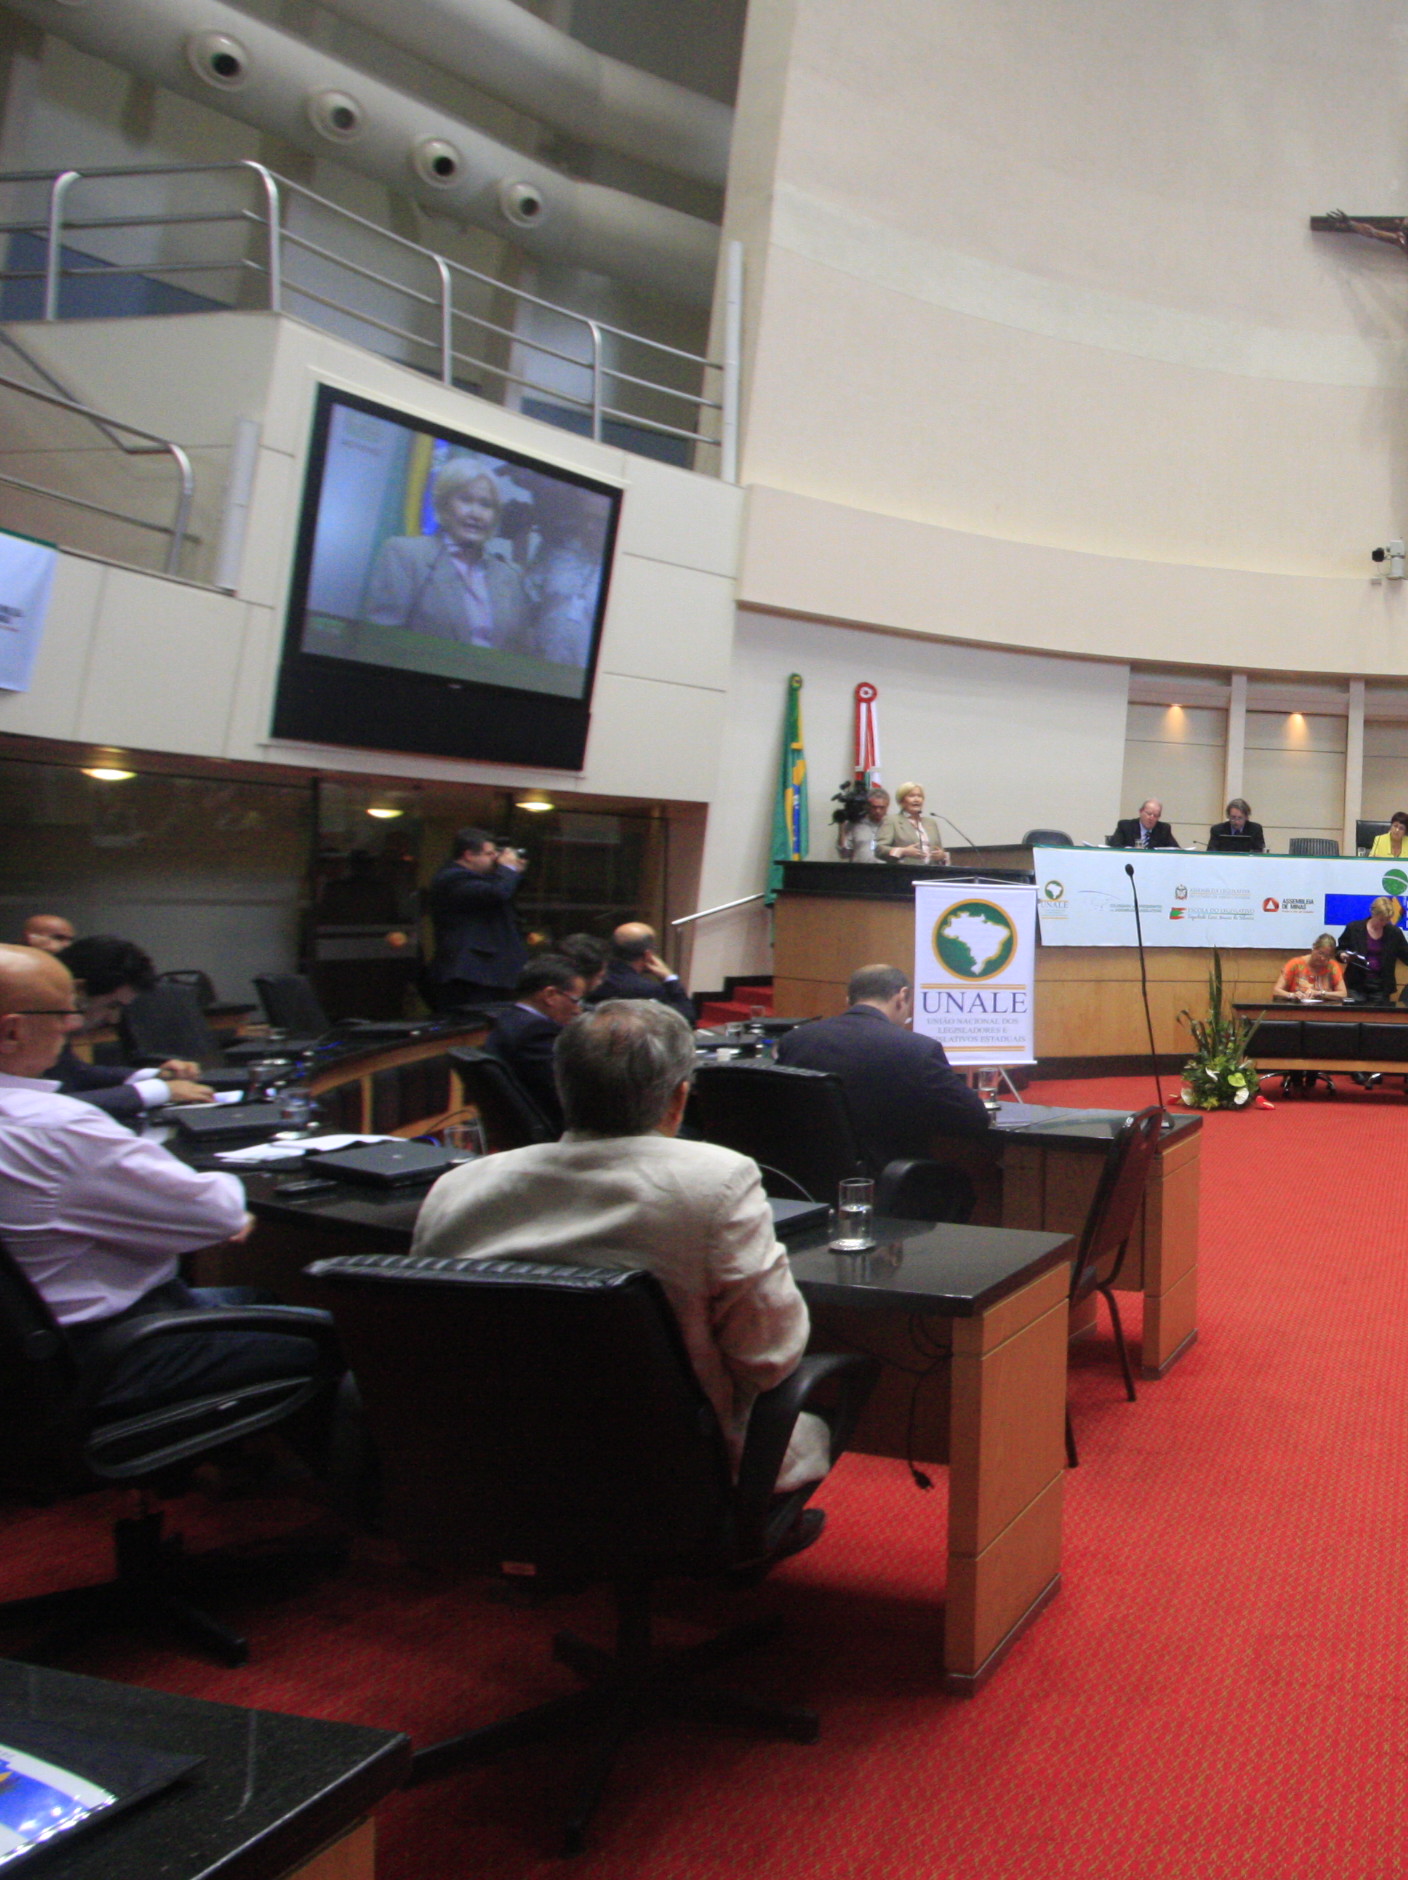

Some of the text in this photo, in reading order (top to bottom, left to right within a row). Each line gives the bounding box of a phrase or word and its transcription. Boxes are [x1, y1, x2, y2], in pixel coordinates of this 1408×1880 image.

[921, 991, 1028, 1014] UNALE
[956, 1017, 1000, 1025] NACIONAL
[1001, 1017, 1019, 1025] DOS
[980, 1035, 1026, 1043] ESTADUAIS
